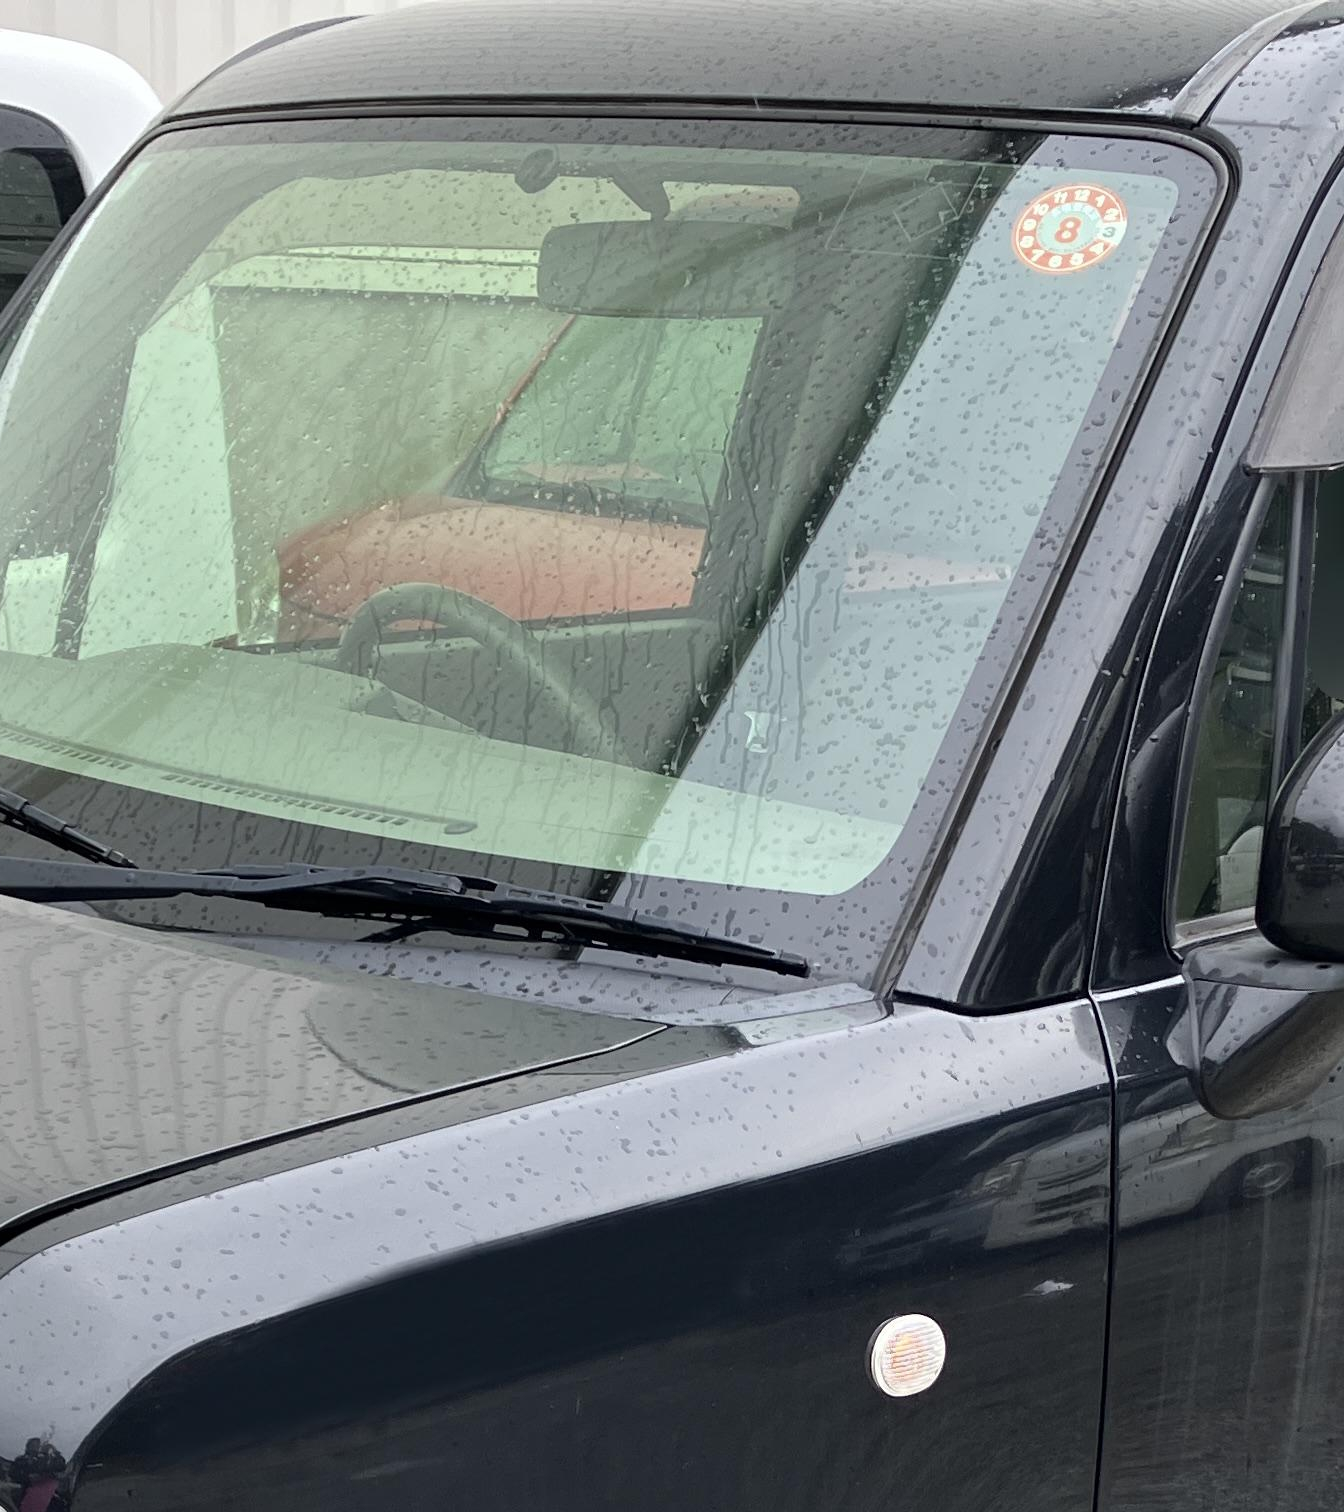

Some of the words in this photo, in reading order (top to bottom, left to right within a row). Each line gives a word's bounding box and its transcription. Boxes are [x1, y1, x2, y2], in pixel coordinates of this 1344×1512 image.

[1053, 191, 1069, 204] 11
[1074, 189, 1091, 202] 12
[1095, 194, 1106, 208] 1
[1033, 203, 1049, 216] 10
[1104, 208, 1120, 221] 2
[1022, 218, 1037, 231] 9
[1054, 216, 1082, 243] 8
[1102, 226, 1116, 238] 3
[1019, 235, 1035, 248] 8
[1031, 249, 1045, 262] 7
[1089, 242, 1105, 256] 4
[1048, 255, 1063, 268] 6
[1069, 252, 1086, 266] 5
